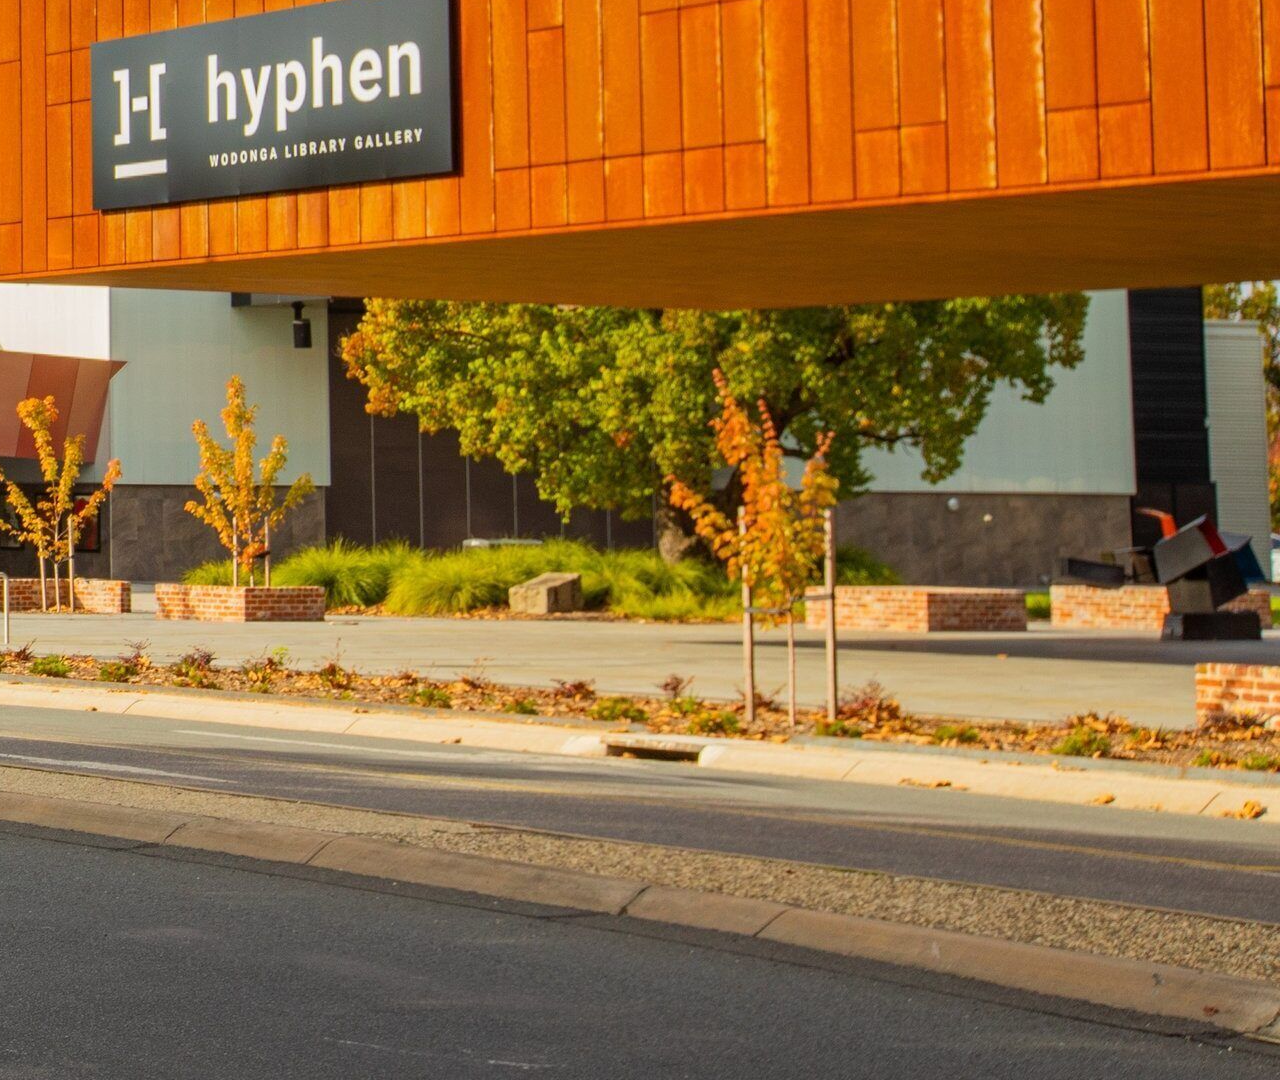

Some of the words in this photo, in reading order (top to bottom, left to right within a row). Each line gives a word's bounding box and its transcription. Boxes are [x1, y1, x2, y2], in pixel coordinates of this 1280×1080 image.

[207, 36, 423, 137] hyphen
[209, 146, 278, 168] WODONGA
[284, 137, 346, 159] LIBRARY
[354, 127, 423, 150] GALLERY
